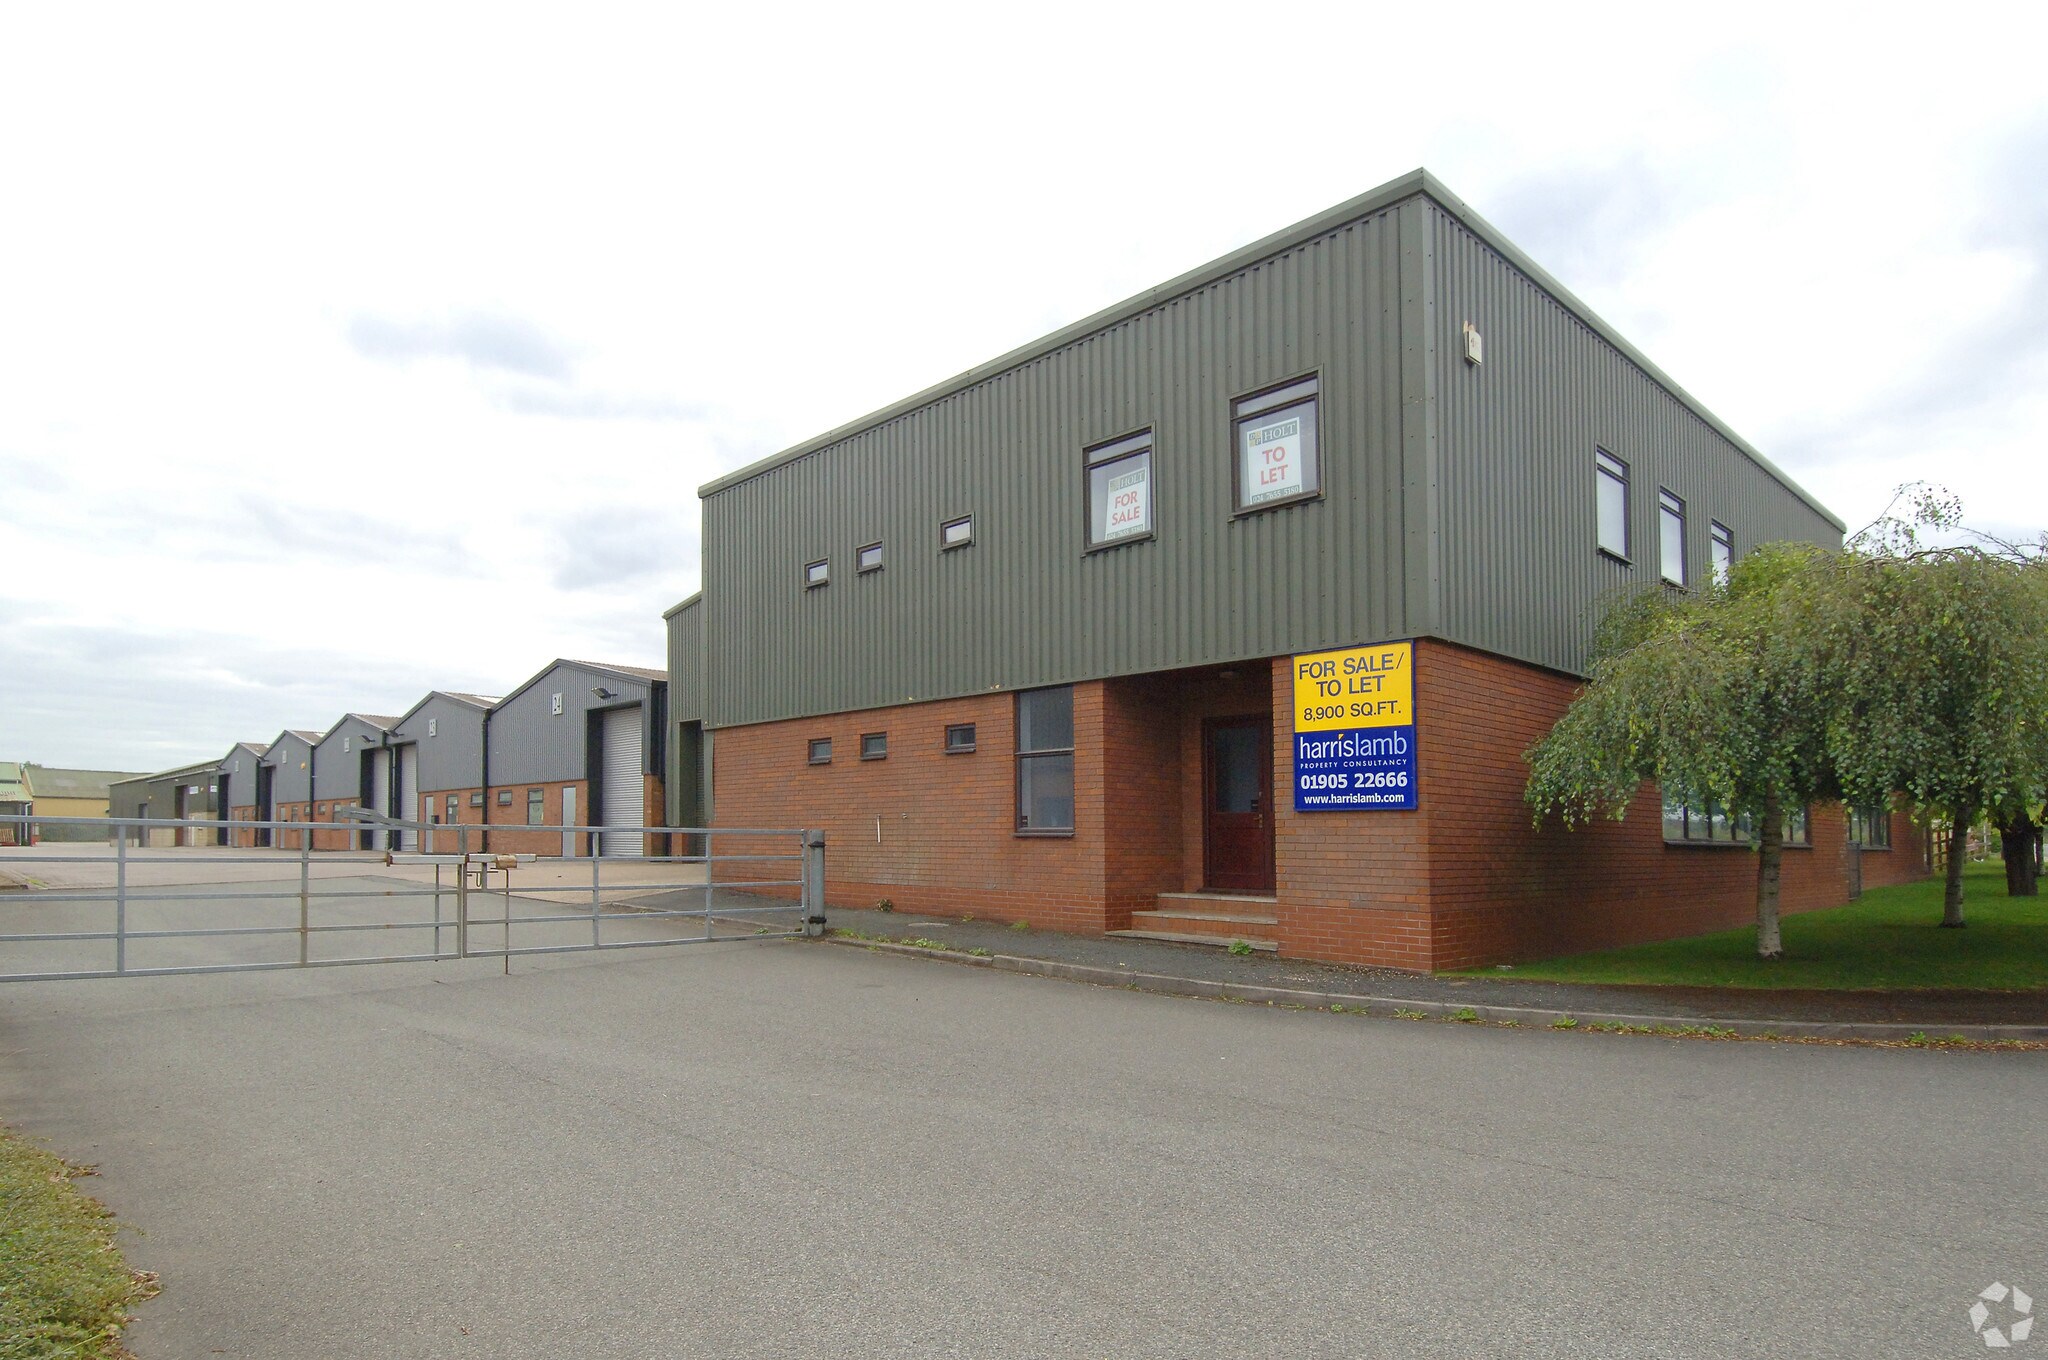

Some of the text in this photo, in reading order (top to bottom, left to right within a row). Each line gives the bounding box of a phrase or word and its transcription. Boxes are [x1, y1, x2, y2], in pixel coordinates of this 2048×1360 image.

[1264, 423, 1296, 441] HOLT
[1262, 446, 1286, 465] TO
[1121, 472, 1143, 488] HOLT
[1261, 464, 1288, 486] LET
[1115, 491, 1138, 509] FOR
[1112, 506, 1140, 526] SALE
[1299, 652, 1404, 680] FOR SALE/
[1316, 675, 1386, 697] TO LET
[1303, 700, 1401, 722] 8,900 SQ.FT.
[1300, 730, 1407, 759] harrislamb
[1300, 759, 1407, 769] PROPERTY CONSULTANCY
[1300, 771, 1408, 790] 01905 22666
[1304, 792, 1405, 804] www.harrislamb.com
